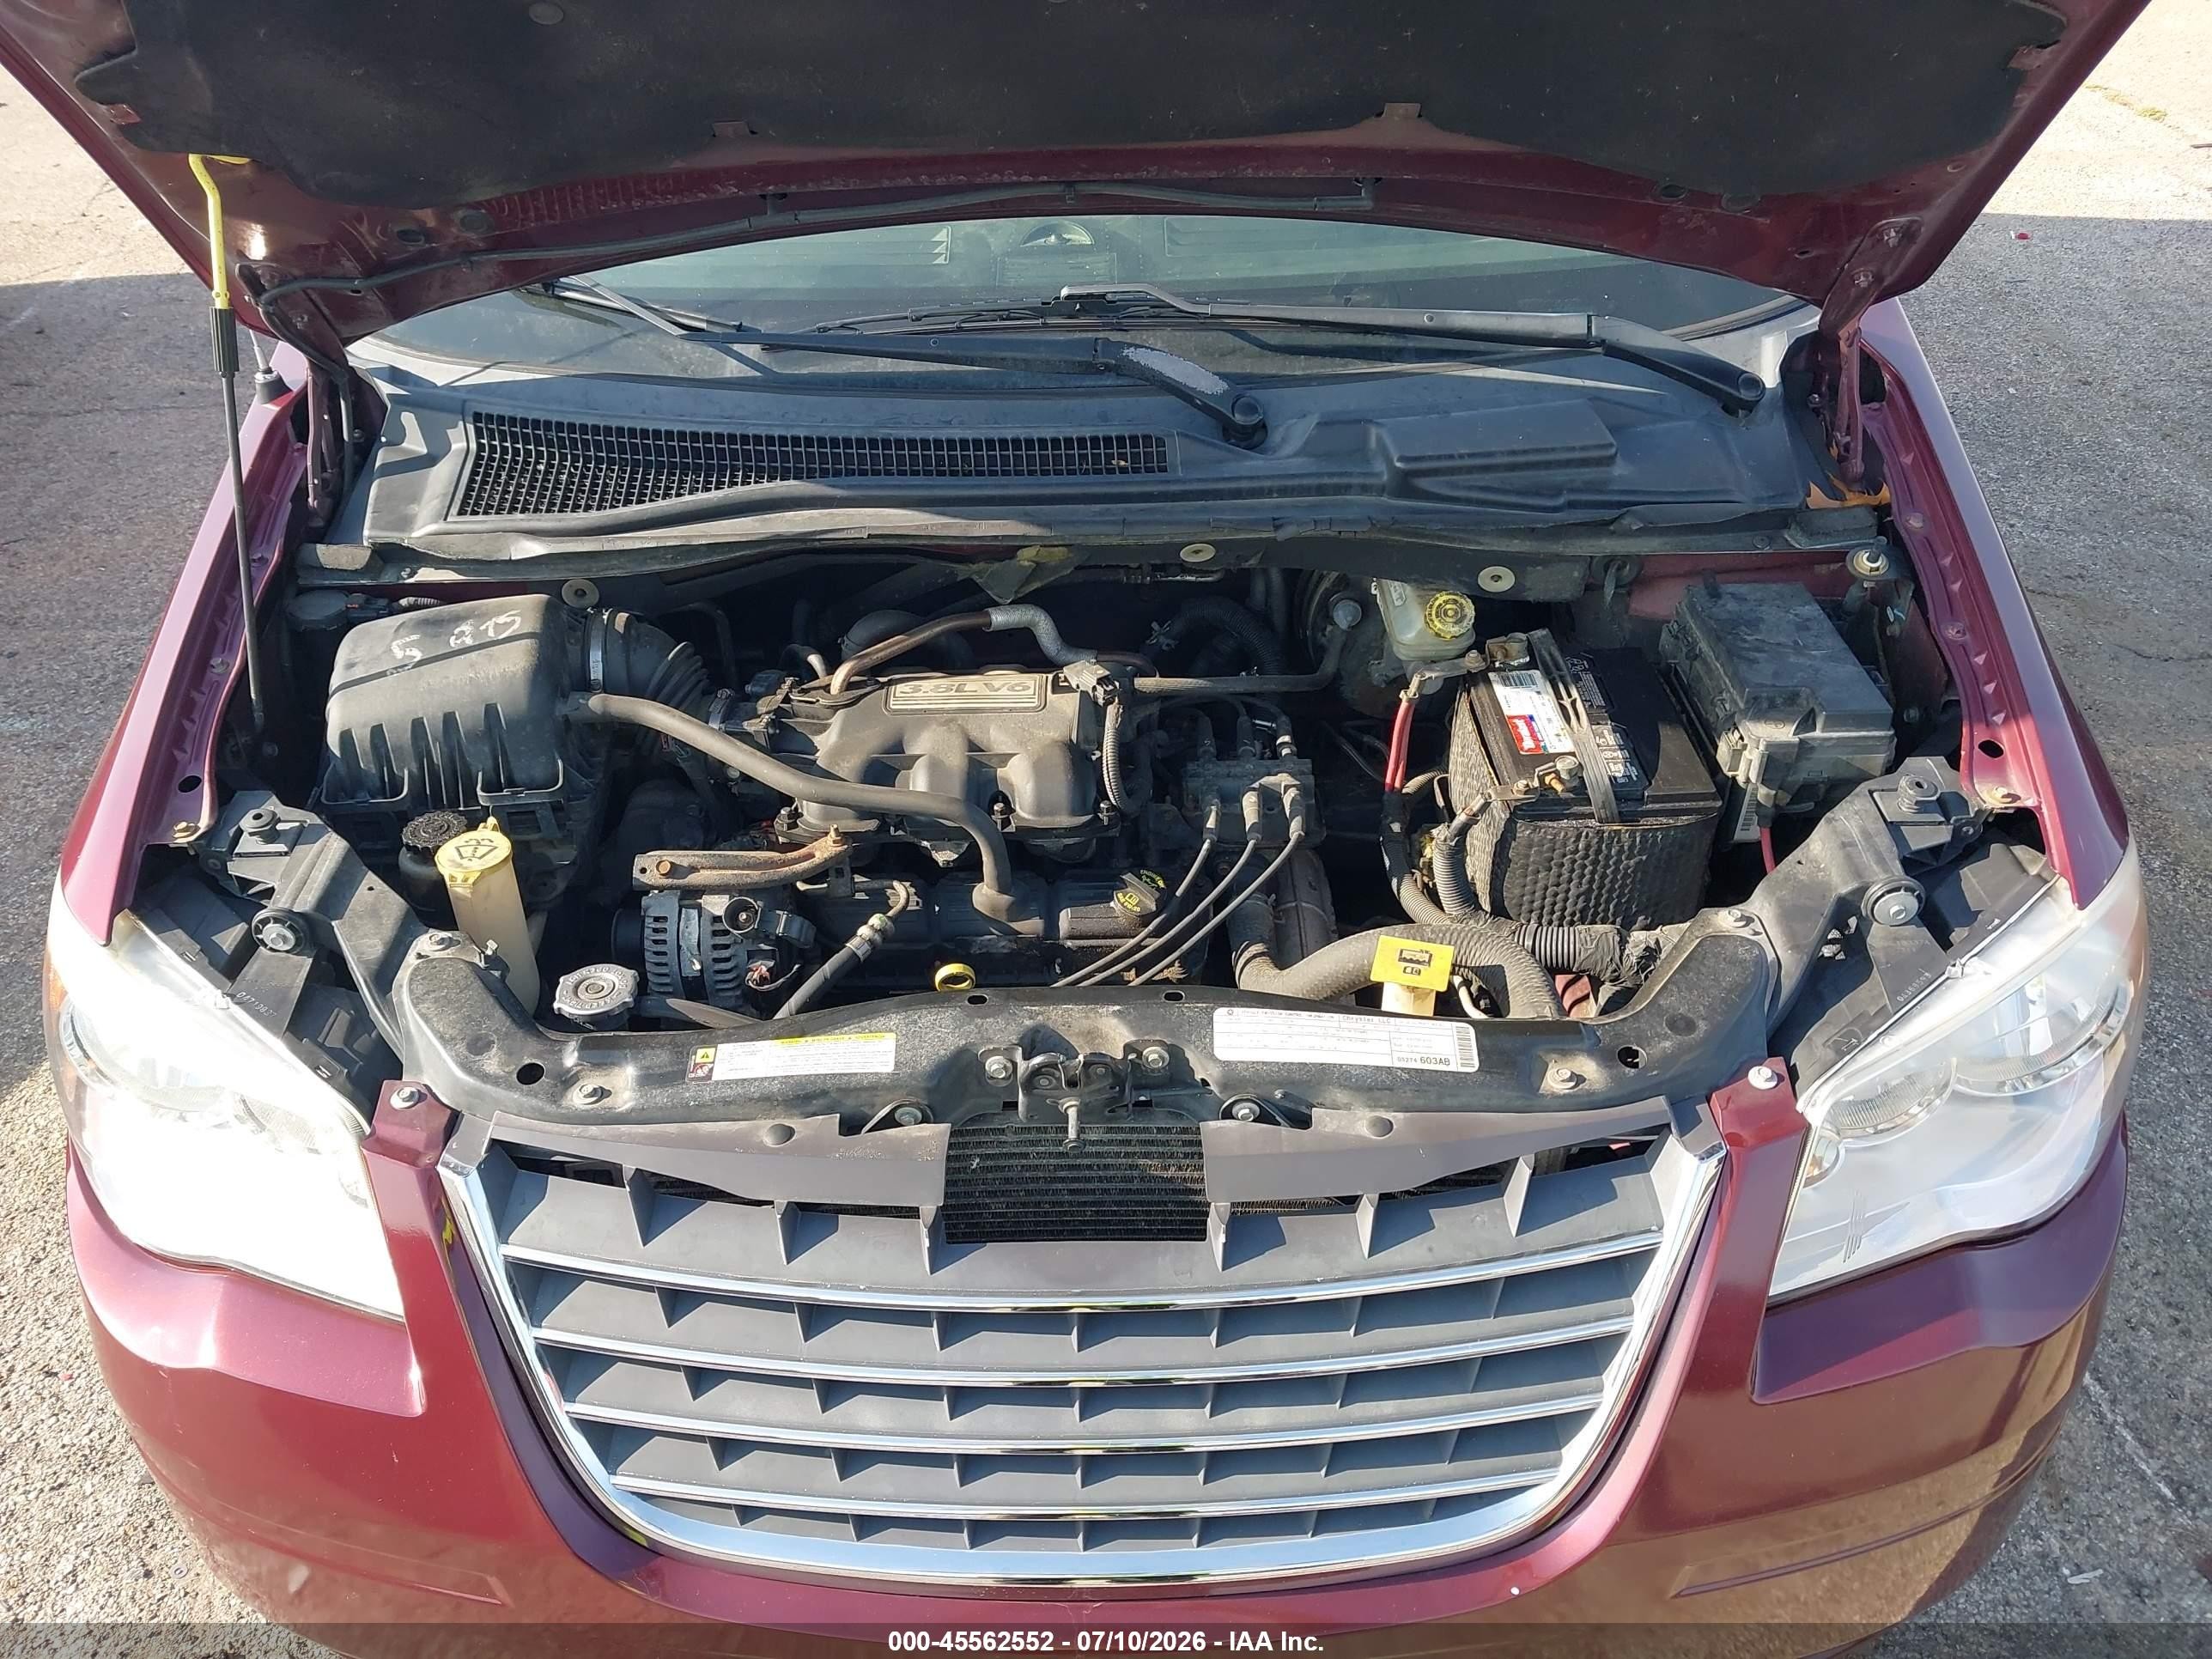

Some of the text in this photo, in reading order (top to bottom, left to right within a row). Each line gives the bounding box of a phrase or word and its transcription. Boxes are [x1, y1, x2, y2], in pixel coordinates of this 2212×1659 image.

[899, 681, 1031, 695] 3.8L V6
[1342, 1015, 1375, 1024] Chrysler
